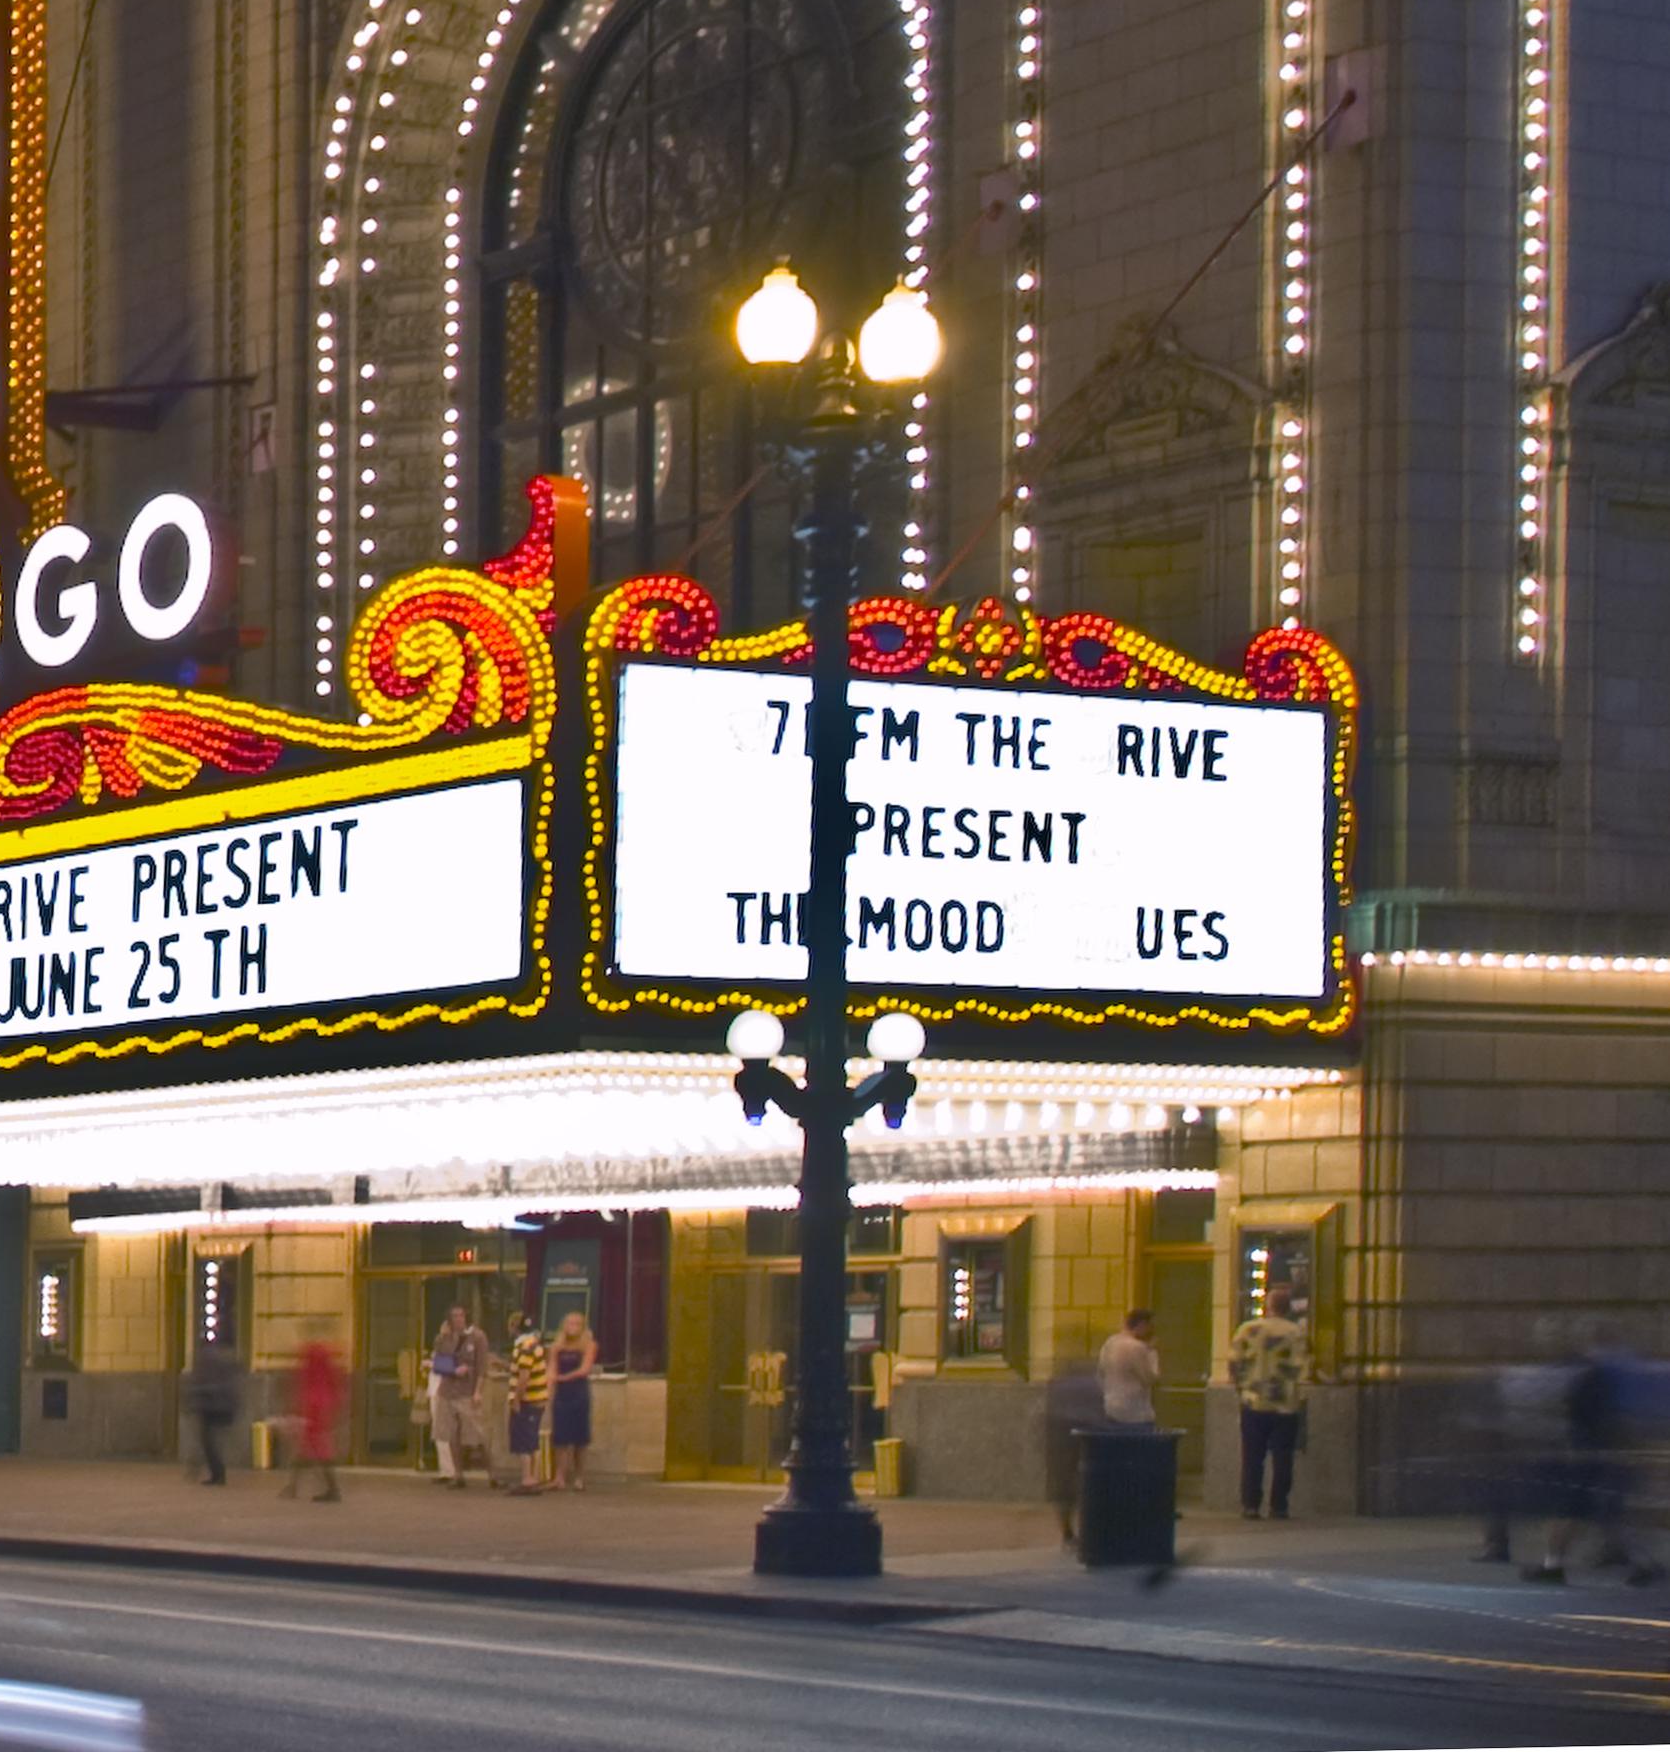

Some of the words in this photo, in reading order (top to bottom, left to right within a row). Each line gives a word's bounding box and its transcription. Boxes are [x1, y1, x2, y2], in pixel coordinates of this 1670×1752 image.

[956, 713, 1051, 770] THE
[1118, 724, 1228, 781] RIVE
[847, 801, 1086, 864] PRESENT
[133, 819, 358, 922] PRESENT
[859, 897, 1004, 953] MOOD
[1137, 907, 1228, 961] UES
